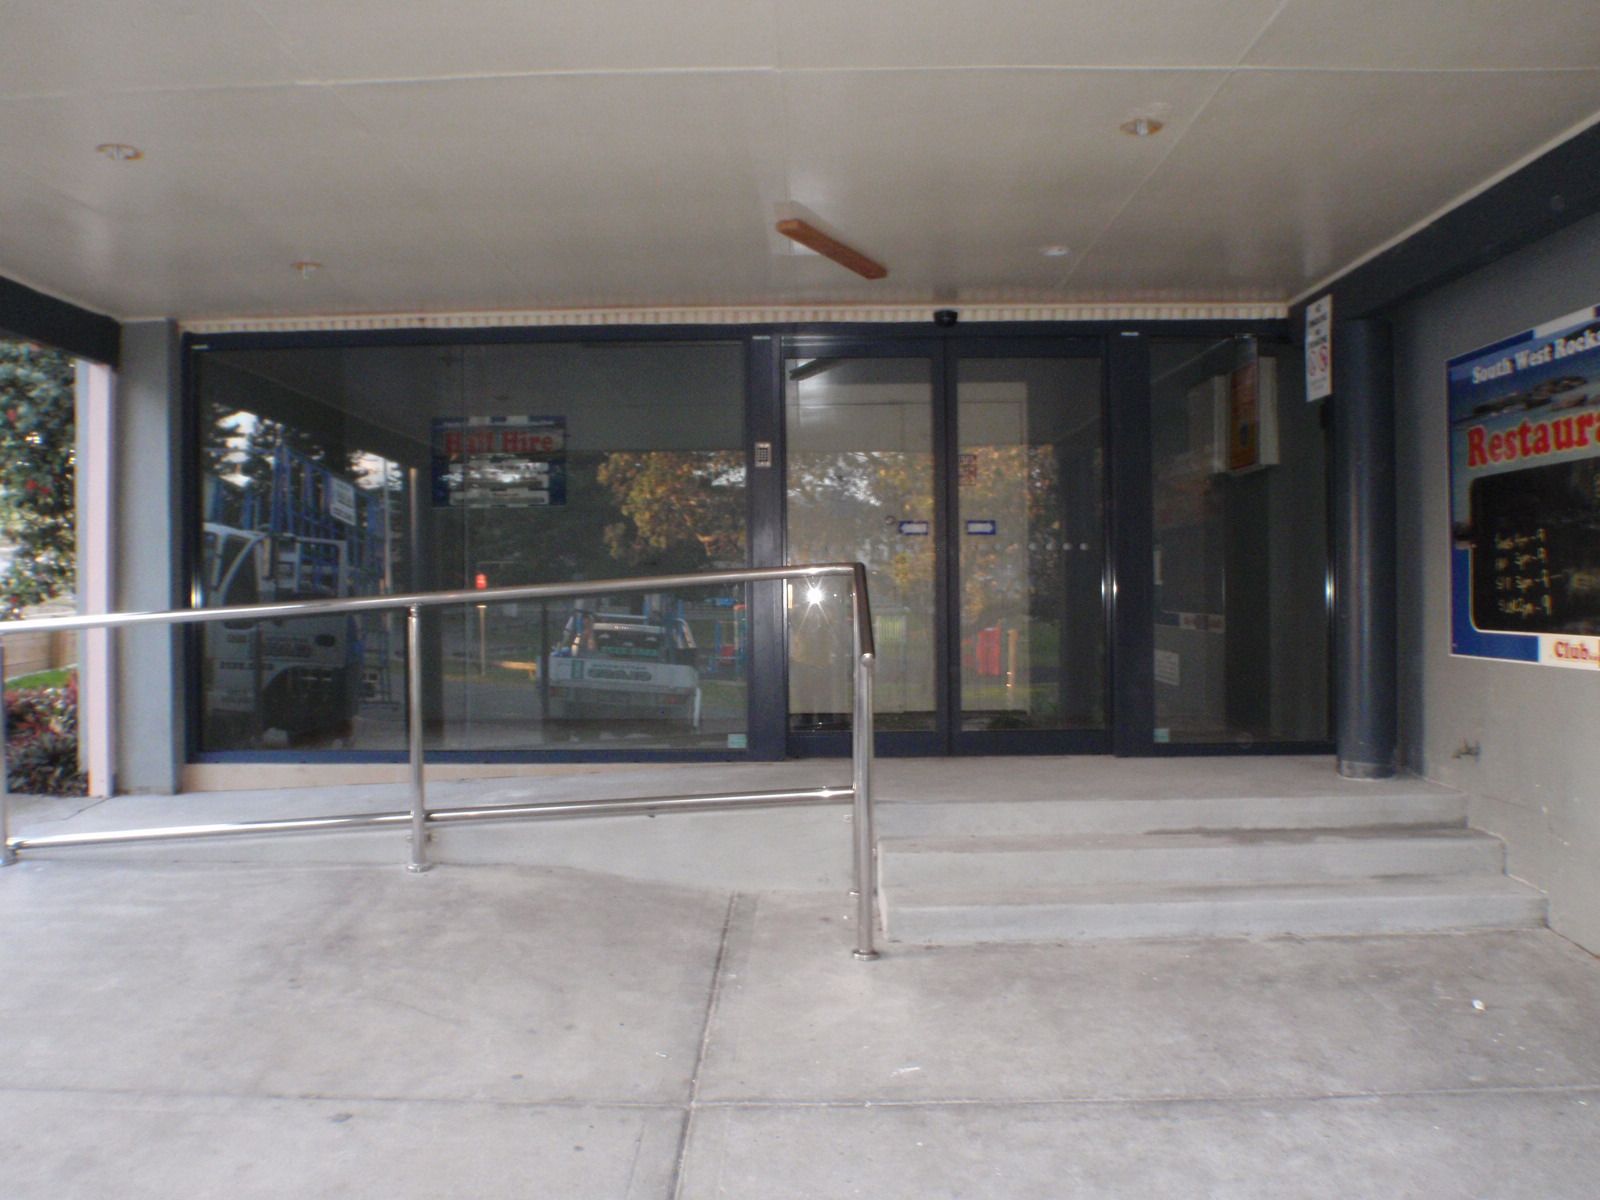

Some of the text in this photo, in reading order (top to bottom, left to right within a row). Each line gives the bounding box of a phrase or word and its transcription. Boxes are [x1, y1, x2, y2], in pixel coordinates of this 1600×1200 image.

[1473, 330, 1600, 383] South West Rock
[1468, 412, 1600, 467] Restaur
